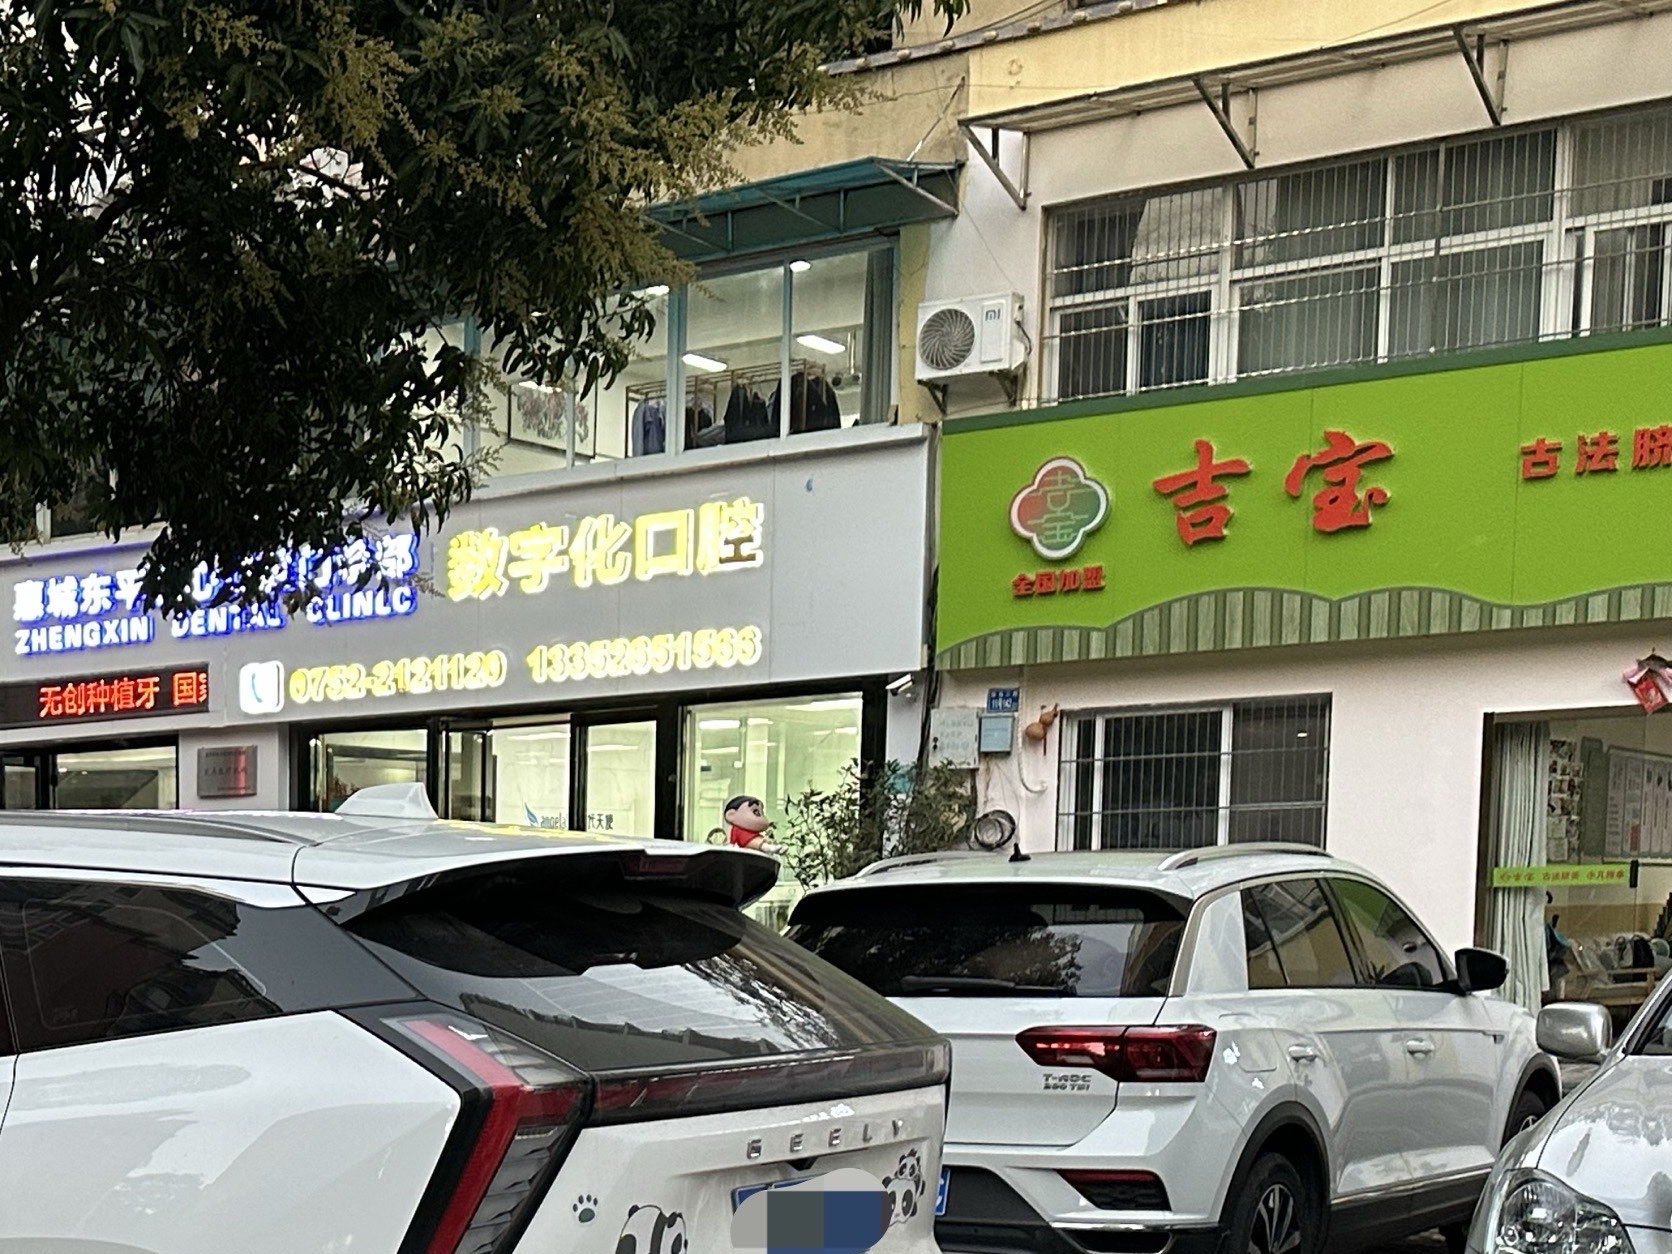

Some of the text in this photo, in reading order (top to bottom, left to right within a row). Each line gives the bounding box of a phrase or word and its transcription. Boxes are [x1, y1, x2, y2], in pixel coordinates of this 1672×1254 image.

[1152, 429, 1394, 545] 吉宝
[448, 496, 764, 601] 数字化口腔
[1011, 566, 1107, 597] 全国加盟
[15, 615, 153, 656] ZHENGXIN
[39, 676, 161, 718] 无创种植牙
[747, 1119, 904, 1160] GEELY
